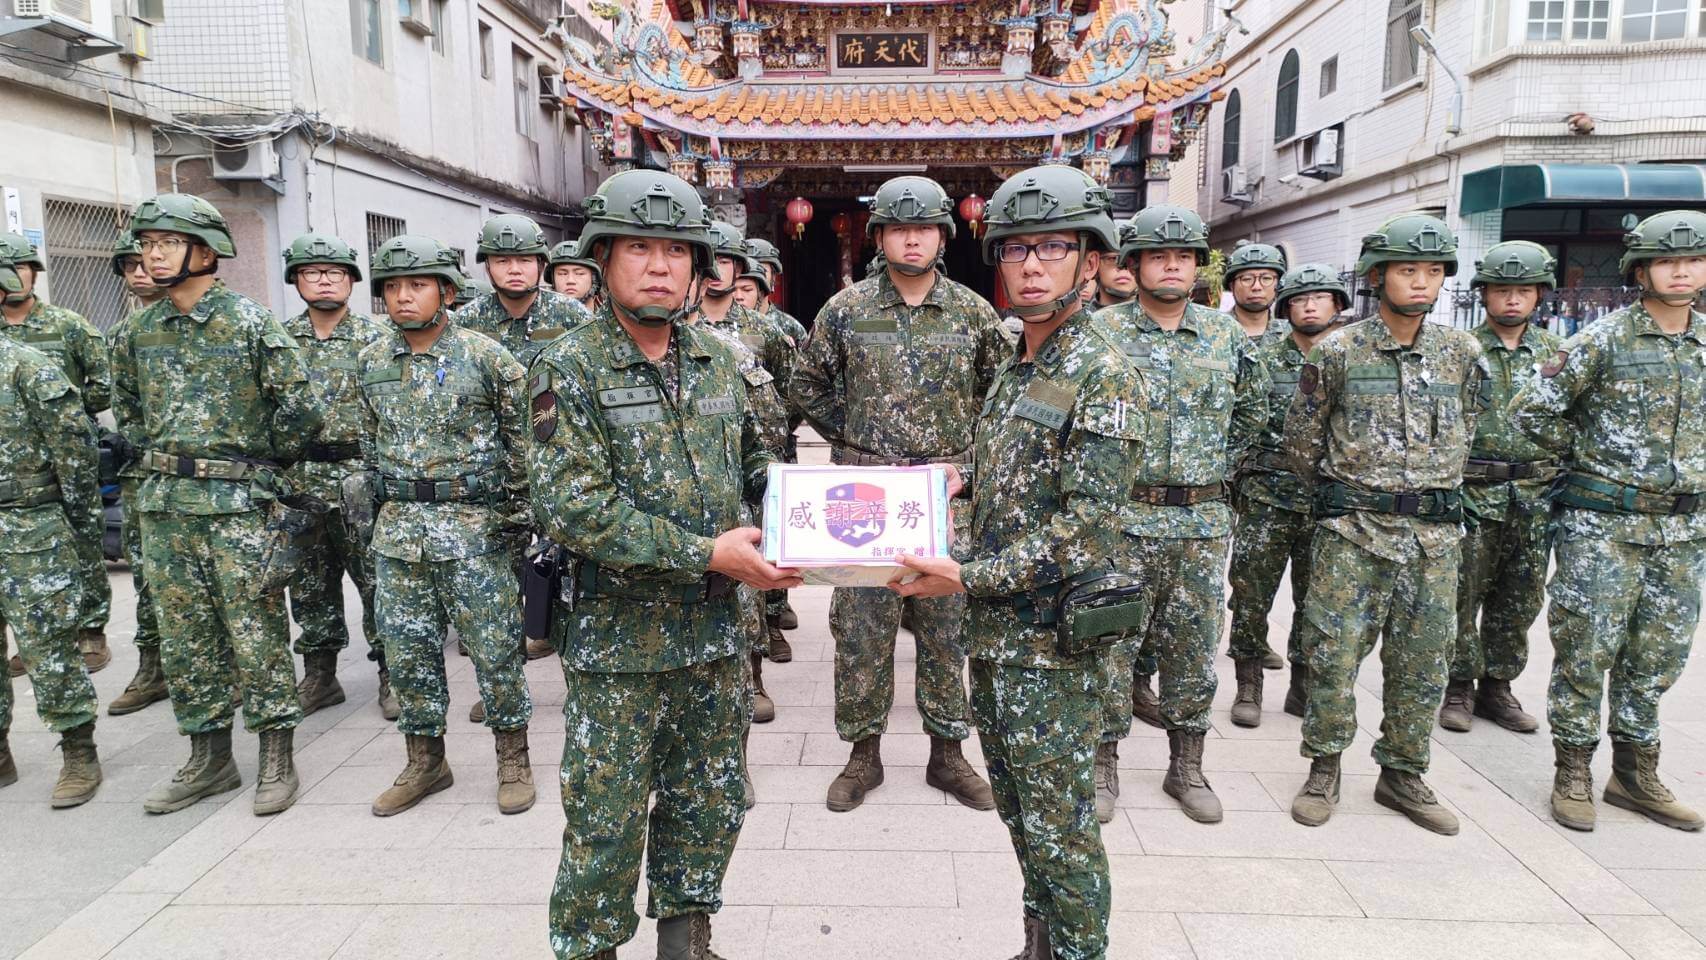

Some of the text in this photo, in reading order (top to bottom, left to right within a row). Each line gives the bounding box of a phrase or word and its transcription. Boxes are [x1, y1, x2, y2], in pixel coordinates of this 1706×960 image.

[844, 38, 921, 65] 代天府
[788, 501, 925, 530] 感謝辛勞
